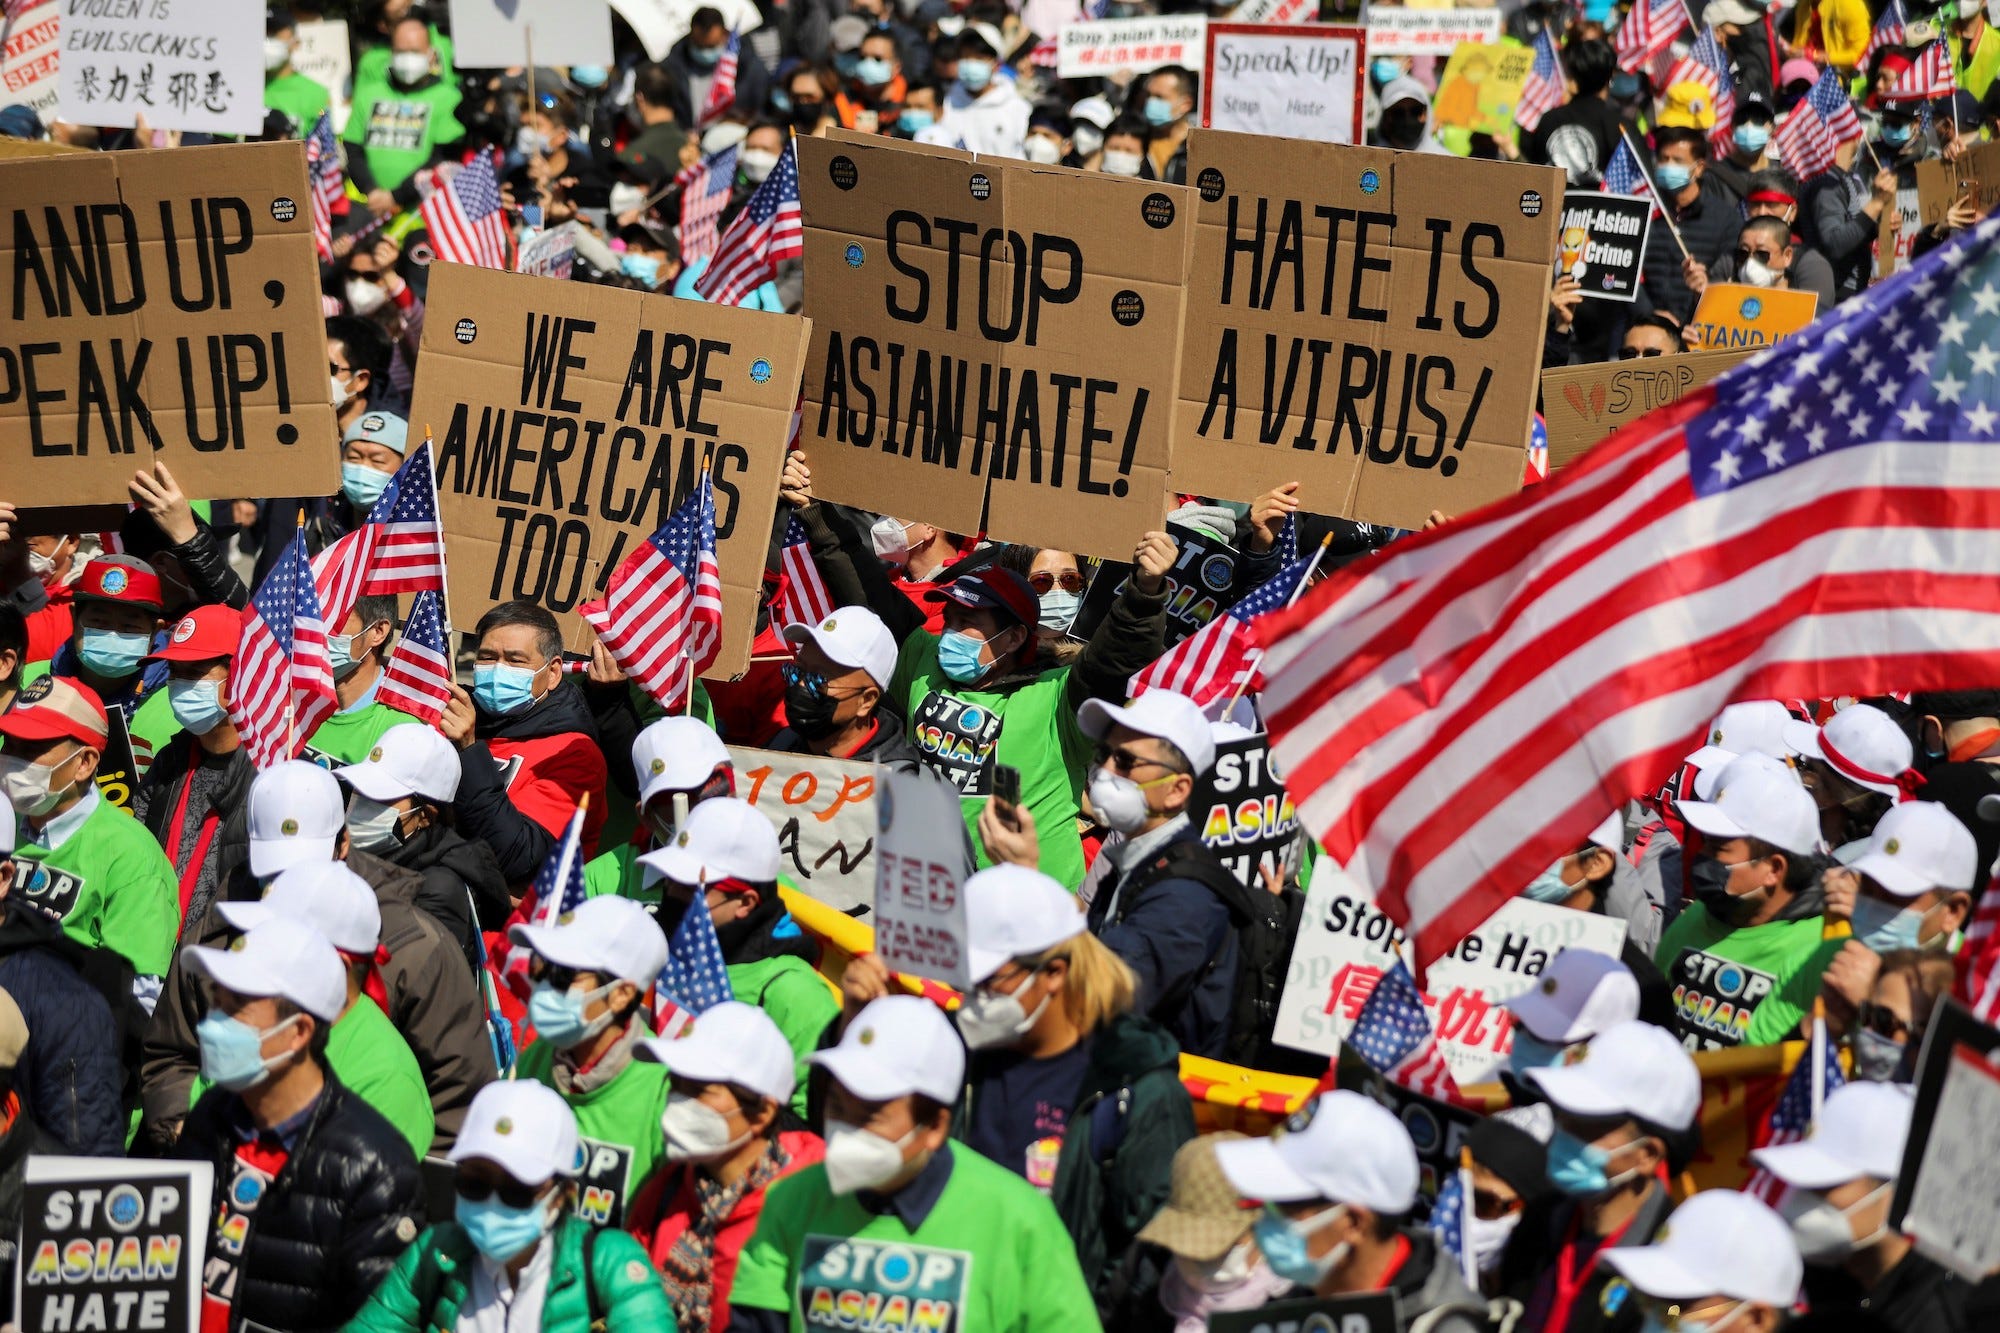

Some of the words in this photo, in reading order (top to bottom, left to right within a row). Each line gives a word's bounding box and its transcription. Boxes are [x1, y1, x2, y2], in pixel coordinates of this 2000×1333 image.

[1217, 44, 1298, 79] Speak
[1566, 207, 1640, 236] Anti-Asian
[13, 202, 147, 320] AND
[159, 197, 285, 312] UP,
[885, 209, 1083, 346] STOP
[1220, 196, 1396, 322] HATE
[1415, 218, 1505, 339] IS
[1583, 241, 1633, 268] Crime
[176, 332, 299, 452] UP!
[520, 312, 596, 413] WE
[615, 330, 731, 437] ARE
[1608, 365, 1694, 414] STOP
[1197, 328, 1237, 440] A
[1258, 333, 1493, 477] VIRUS!
[435, 403, 748, 540] AMERICANS
[925, 697, 999, 740] STOP
[1325, 895, 1406, 954] Stop
[1685, 953, 1772, 1003] STOP
[44, 1184, 180, 1232] STOP
[26, 1235, 182, 1285] ASIAN
[819, 1243, 955, 1292] STOP
[41, 1290, 170, 1333] HATE
[807, 1286, 952, 1333] ASIAN
